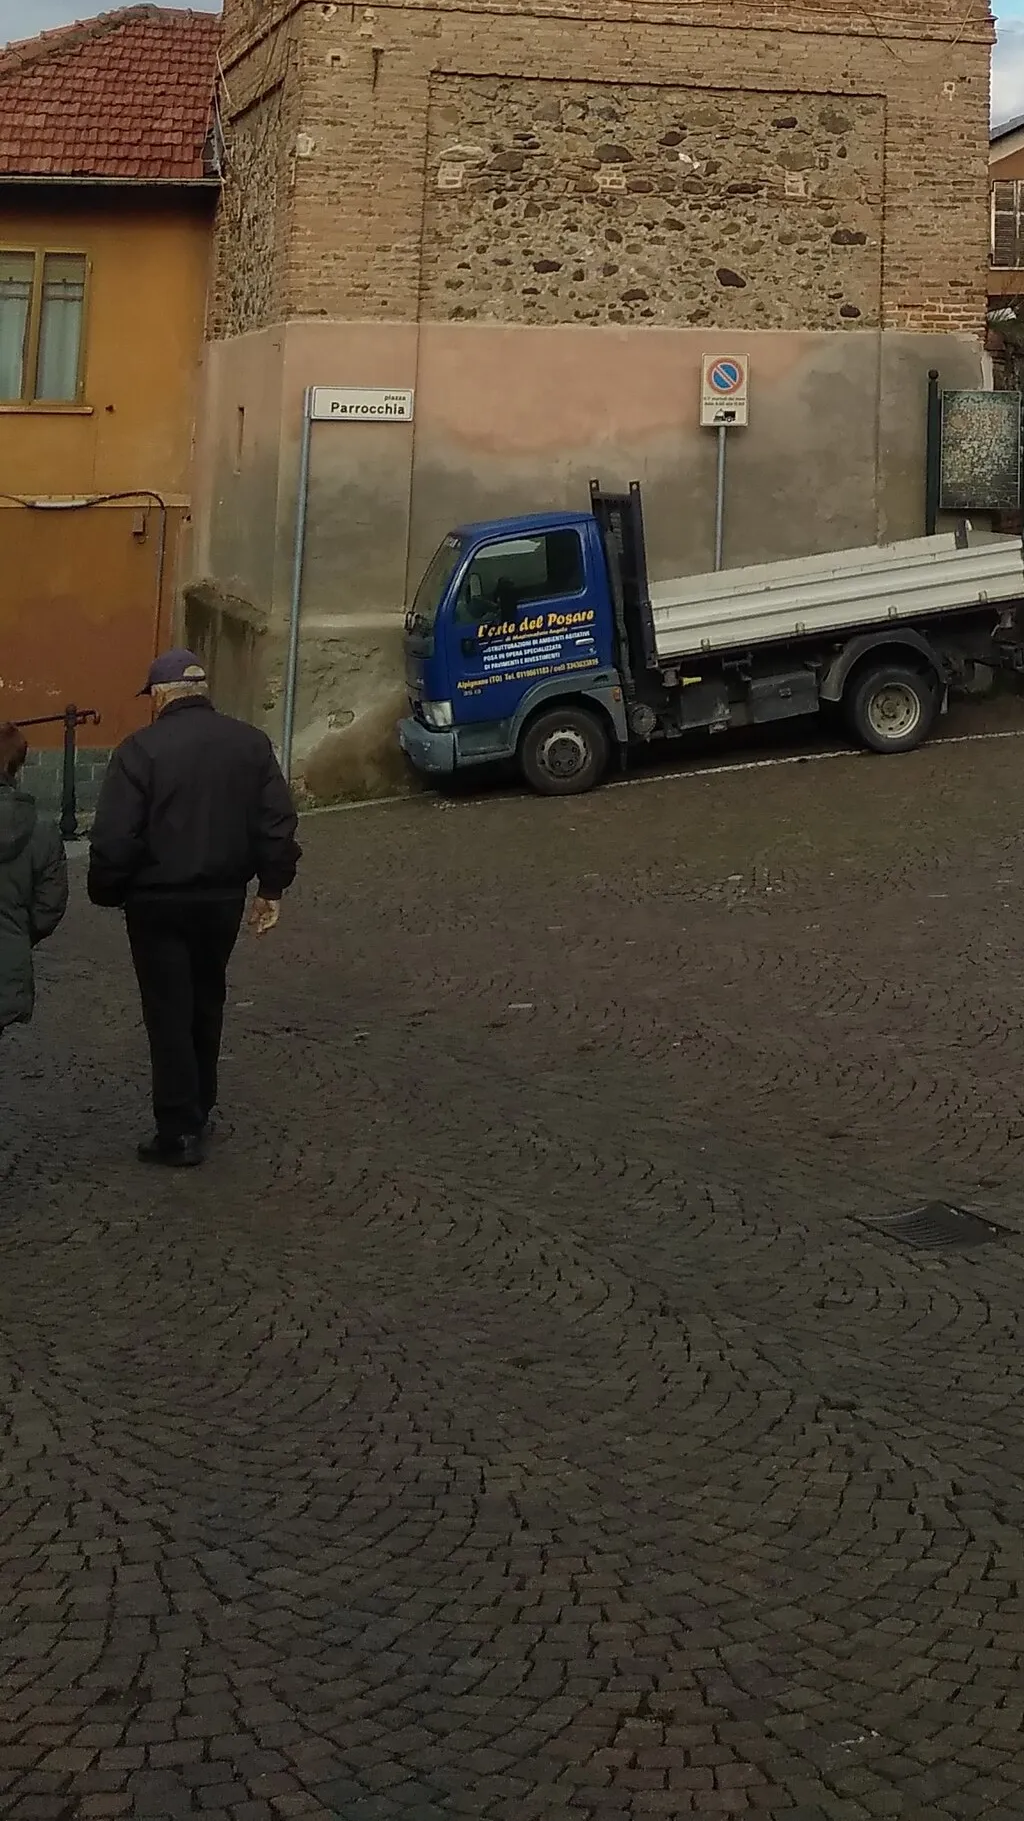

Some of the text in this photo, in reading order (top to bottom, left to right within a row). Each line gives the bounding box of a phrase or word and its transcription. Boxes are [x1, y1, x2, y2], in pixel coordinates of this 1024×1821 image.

[331, 401, 405, 414] Parrocchia
[519, 614, 544, 632] del
[547, 609, 595, 627] Posare
[483, 654, 498, 662] POSA
[505, 650, 523, 659] OPERA
[524, 643, 562, 656] SPECIALIZZATA
